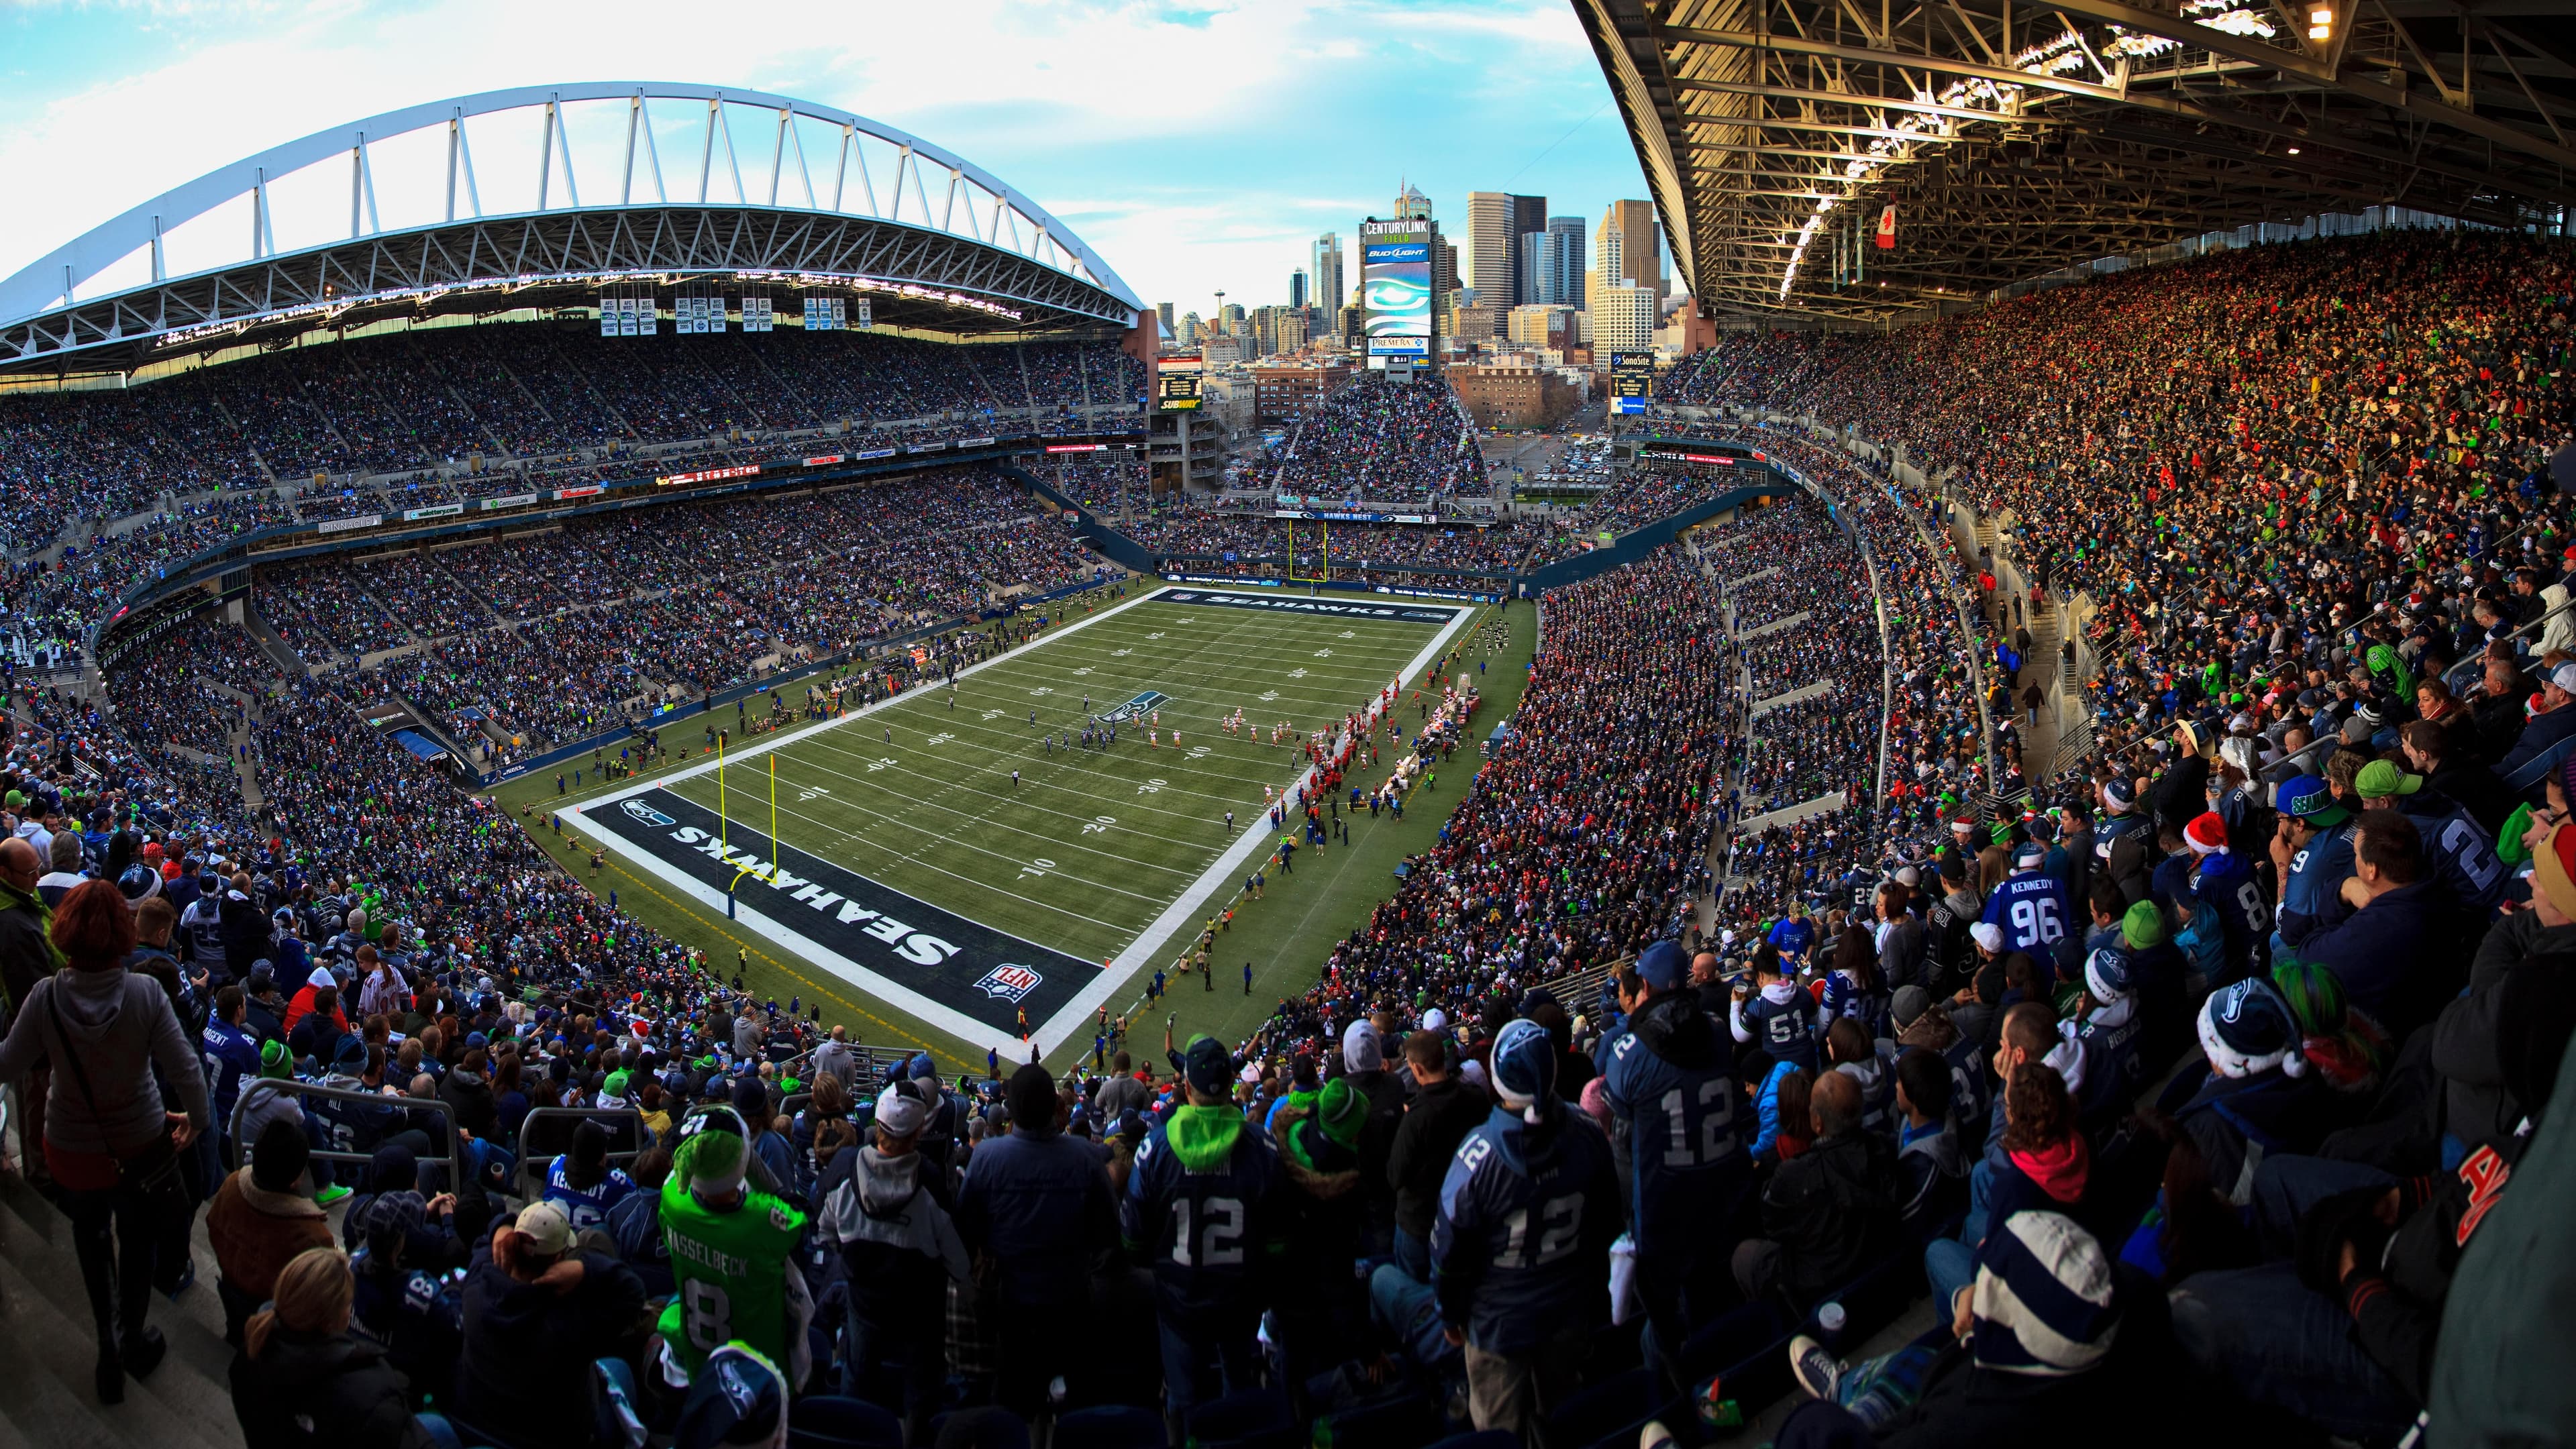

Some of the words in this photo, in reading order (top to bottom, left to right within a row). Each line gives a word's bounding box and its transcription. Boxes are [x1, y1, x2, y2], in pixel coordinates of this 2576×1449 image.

[1366, 221, 1427, 235] CENTURYLINK
[1384, 234, 1410, 243] FIELD
[1373, 338, 1410, 347] PREMERA
[1622, 355, 1651, 366] SonoSite
[1160, 398, 1201, 409] SUBWAY
[909, 445, 923, 453] Safeco
[561, 488, 599, 499] Budweiser
[499, 497, 528, 506] CenturyLink
[418, 506, 458, 517] walottery.com
[324, 519, 370, 531] PINNACLE
[1204, 596, 1395, 615] SEAHAWKS
[103, 648, 121, 669] HOME
[125, 641, 132, 653] OF
[136, 631, 150, 645] THE
[154, 619, 171, 635] 12TH
[175, 609, 192, 623] MAN
[2367, 651, 2379, 663] 12
[1029, 687, 1053, 696] 50
[655, 707, 664, 716] 12
[982, 709, 1005, 718] 40
[928, 733, 955, 743] 30
[1186, 747, 1211, 758] 40
[868, 757, 897, 769] 20
[799, 786, 829, 799] 10
[1139, 779, 1168, 793] 30
[2233, 791, 2243, 802] 8
[1084, 816, 1117, 833] 20
[2441, 818, 2504, 891] 2
[1022, 859, 1055, 876] 10
[2010, 879, 2055, 894] KENNEDY
[671, 826, 962, 965] SEAHAWKS
[370, 908, 383, 923] 29
[1933, 907, 1952, 928] 51
[2009, 897, 2064, 949] 96
[340, 942, 354, 954] THOMAS
[996, 966, 1037, 989] NFL
[1769, 1008, 1807, 1043] 51
[201, 1027, 230, 1047] ARGENT
[1660, 1076, 1738, 1169] 12
[1133, 1132, 1153, 1167] 2
[1457, 1133, 1492, 1173] 12
[1171, 1196, 1245, 1268] 12
[1492, 1191, 1586, 1269] 12
[666, 1225, 750, 1278] HASSELBECK
[403, 1275, 437, 1315] 18
[684, 1277, 733, 1353] 8
